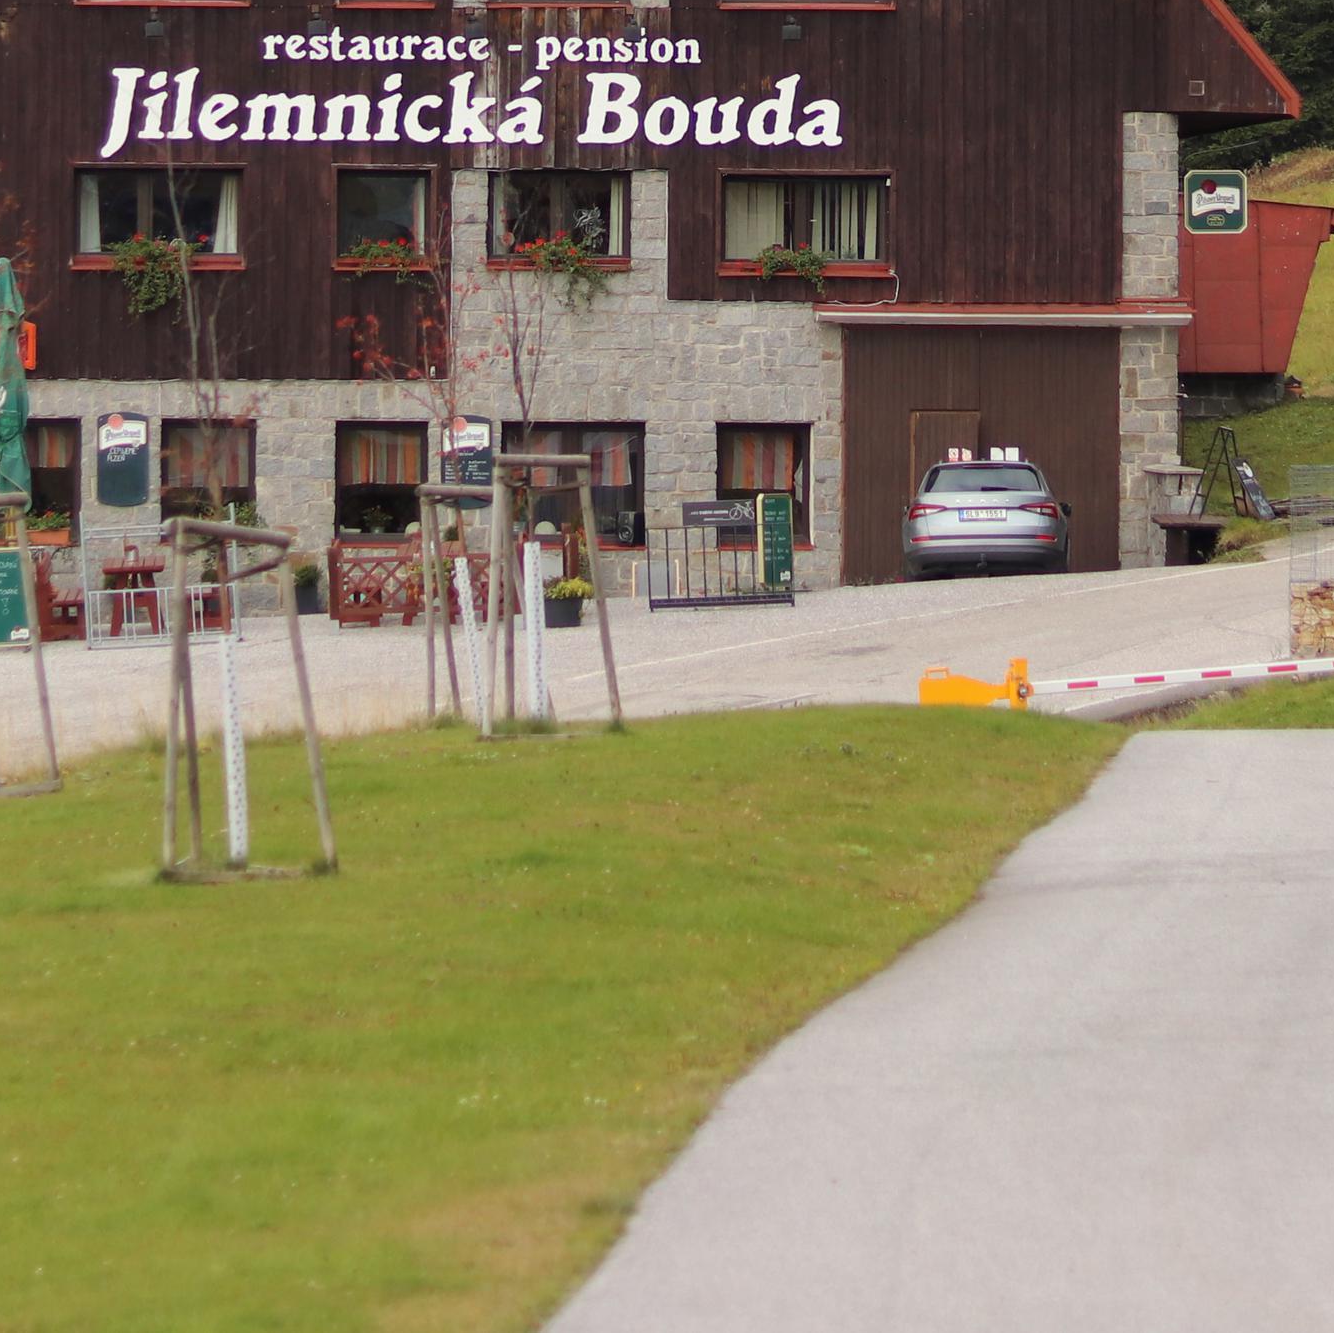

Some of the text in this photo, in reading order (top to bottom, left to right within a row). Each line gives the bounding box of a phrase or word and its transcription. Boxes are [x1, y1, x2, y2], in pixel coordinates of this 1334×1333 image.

[263, 27, 490, 62] restaurace
[536, 27, 701, 70] pension
[101, 67, 842, 158] Jilemnická Bouda
